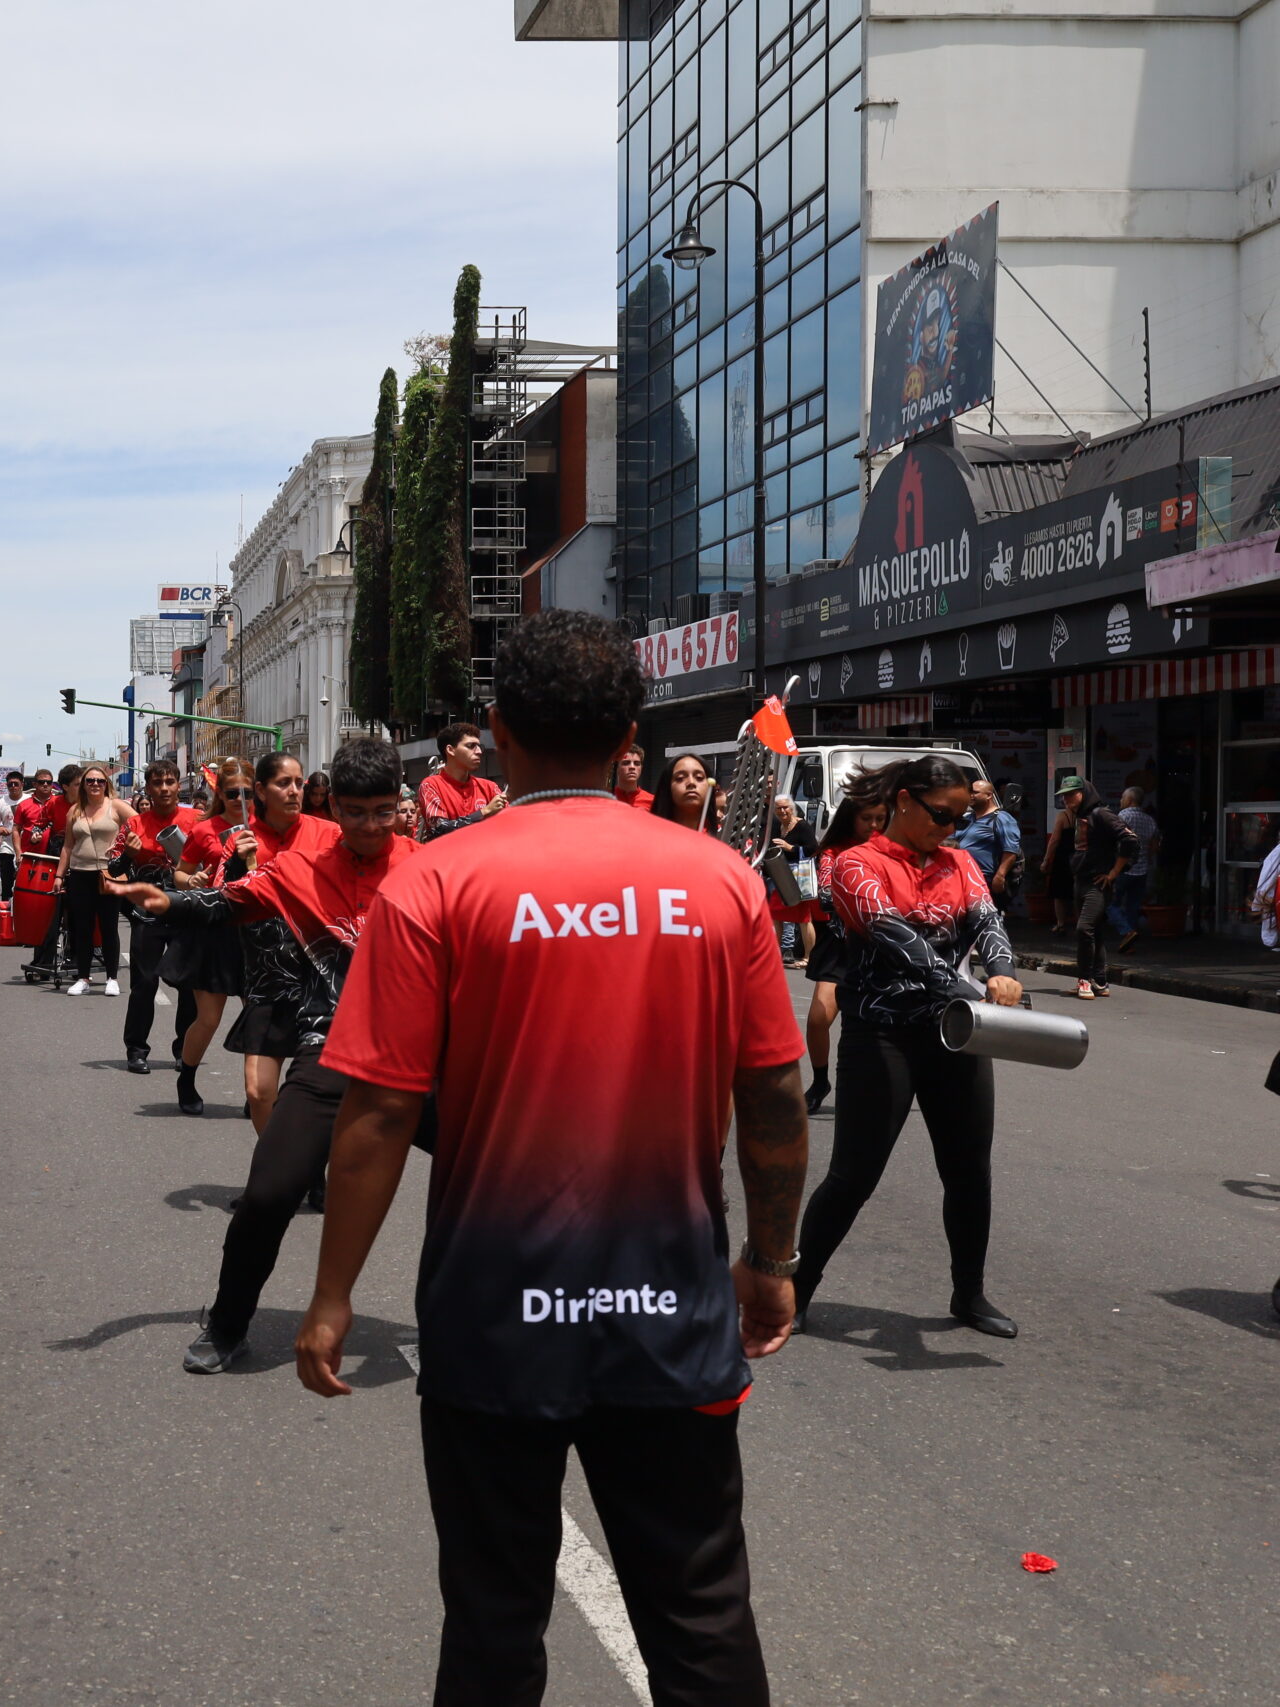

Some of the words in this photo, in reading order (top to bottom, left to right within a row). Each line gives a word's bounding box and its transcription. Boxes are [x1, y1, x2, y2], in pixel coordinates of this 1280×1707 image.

[886, 264, 930, 337] BIENVENIDOS
[930, 257, 937, 271] A
[937, 251, 947, 267] LA
[947, 250, 968, 270] CASA
[967, 258, 980, 282] DEL
[901, 400, 918, 426] TÍO
[919, 384, 953, 416] PAPAS
[1024, 527, 1048, 546] LLEGAMOS
[1049, 523, 1065, 540] HASTA
[1065, 520, 1072, 534] TU
[1072, 515, 1093, 533] PUERTA
[1144, 511, 1158, 520] Uber
[1020, 541, 1055, 582] 4000
[1057, 530, 1094, 574] 2626
[179, 587, 212, 601] BCR
[874, 608, 880, 630] &
[509, 885, 638, 943] Axel
[658, 888, 704, 938] E.
[522, 1283, 678, 1324] Diriente
